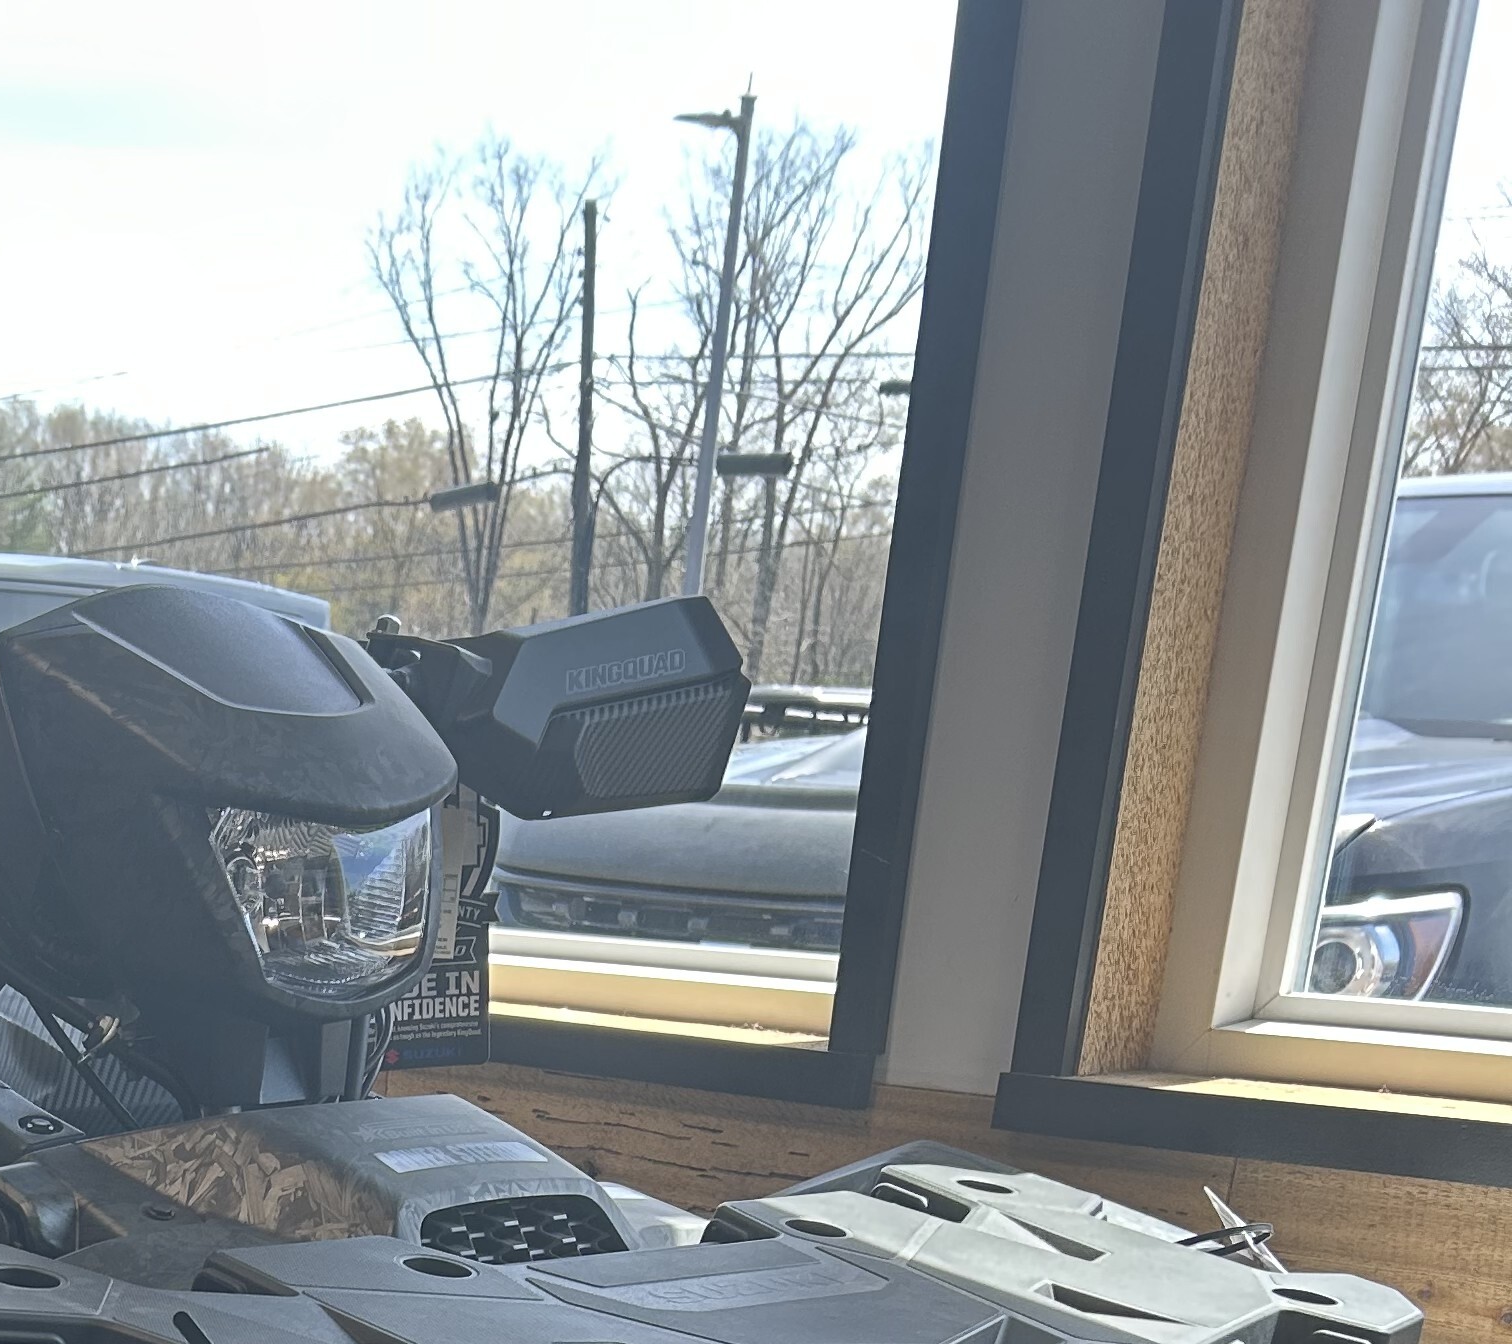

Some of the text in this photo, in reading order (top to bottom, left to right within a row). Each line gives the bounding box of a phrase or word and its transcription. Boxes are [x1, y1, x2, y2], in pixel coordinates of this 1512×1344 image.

[565, 649, 686, 696] KINGQUAD
[445, 970, 480, 995] IN
[390, 995, 480, 1021] NFIDENCE
[403, 1047, 461, 1060] SUZUKI
